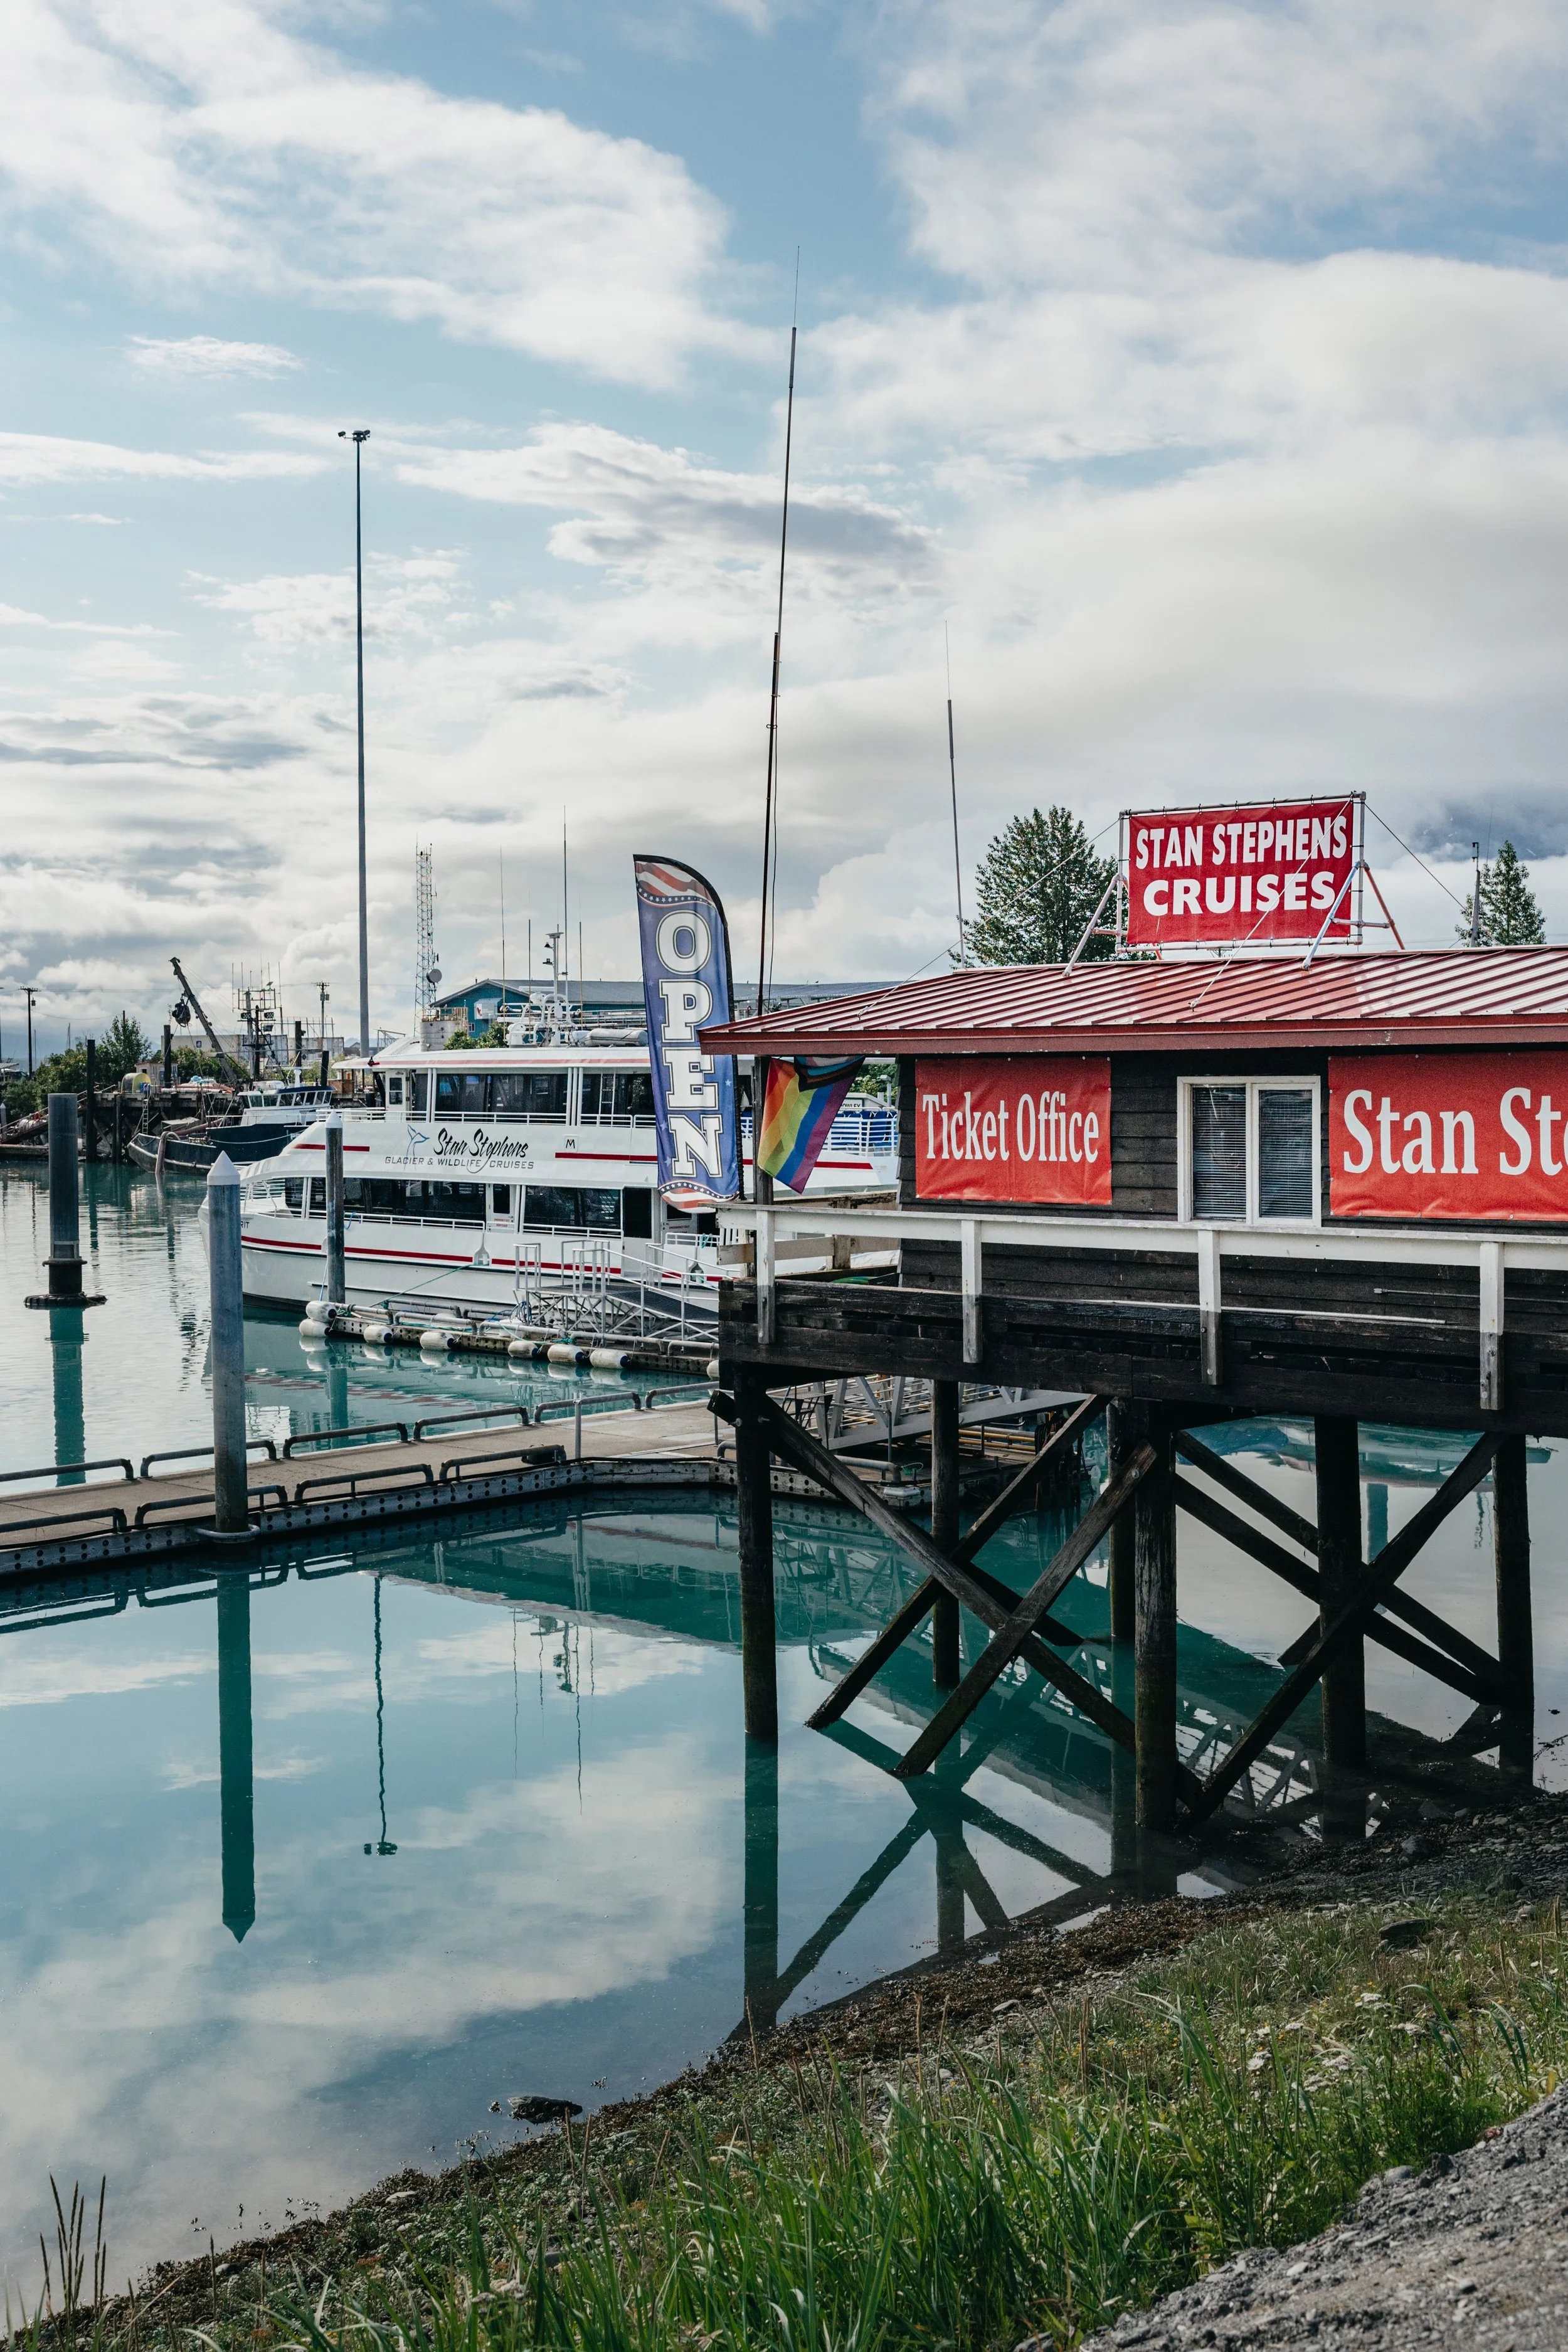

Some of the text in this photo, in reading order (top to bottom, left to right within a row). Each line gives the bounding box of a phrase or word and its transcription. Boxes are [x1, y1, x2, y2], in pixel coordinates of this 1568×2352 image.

[1136, 816, 1347, 870] STAN STEPHENS
[1143, 871, 1335, 916] CRUISES
[655, 909, 723, 1178] OPEN
[433, 1128, 528, 1173] Stan Stephens
[923, 1091, 1099, 1163] Ticket Office
[1343, 1087, 1568, 1176] Stan St
[385, 1157, 424, 1165] GLACIER
[438, 1158, 482, 1167] WILDLIFE
[489, 1160, 534, 1169] CRUISES
[240, 1221, 250, 1229] RIT
